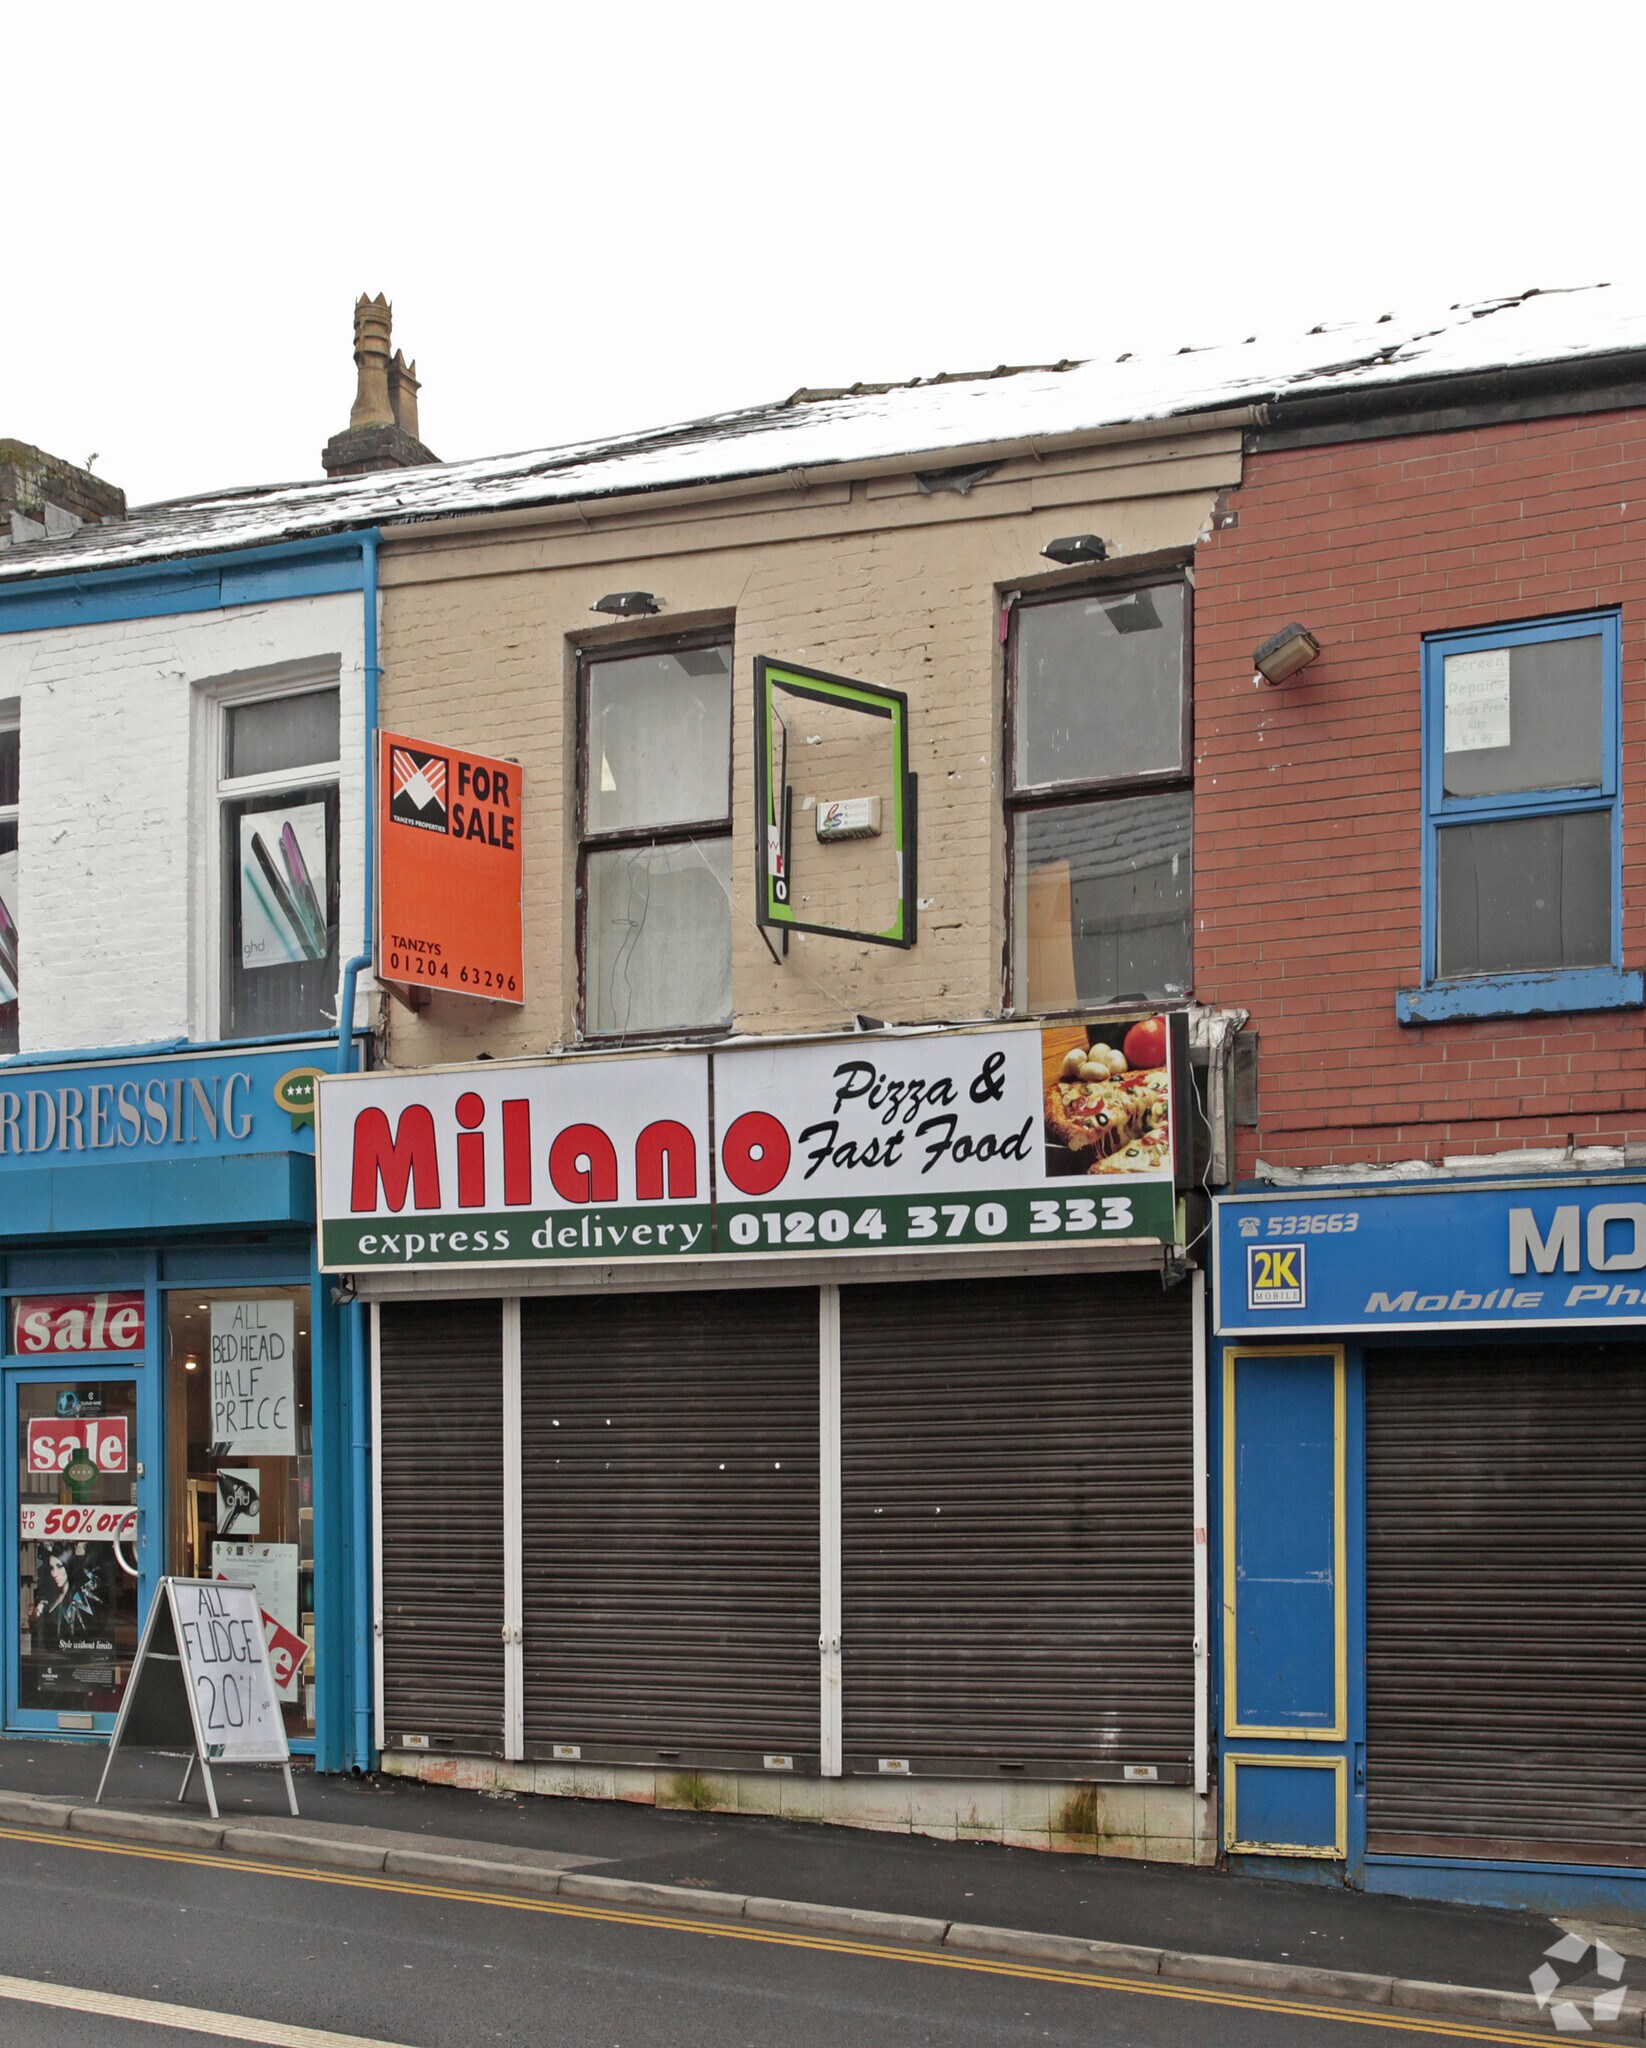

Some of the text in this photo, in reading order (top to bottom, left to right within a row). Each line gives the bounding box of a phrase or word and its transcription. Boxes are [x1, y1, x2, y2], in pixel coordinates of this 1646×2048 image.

[1451, 656, 1504, 673] Screen
[1448, 679, 1505, 698] Repairs
[458, 761, 509, 809] FOR
[393, 815, 446, 833] TANZYS PROPERTIES
[452, 803, 514, 850] SALE
[244, 938, 265, 958] ghd
[391, 935, 441, 956] TANZYS
[391, 953, 516, 991] 01204 63296
[832, 1051, 1005, 1124] Pizza &
[0, 1072, 253, 1154] RDRESSING
[350, 1092, 791, 1213] Milano
[798, 1113, 1034, 1181] Fast Food
[358, 1215, 703, 1261] express delivery
[729, 1197, 1134, 1246] 01204 370 333
[1266, 1212, 1359, 1236] 533663
[1508, 1202, 1646, 1275] MO
[1254, 1251, 1300, 1288] 2K
[1255, 1290, 1298, 1301] MOBILE
[1364, 1288, 1544, 1314] Mobile
[24, 1294, 139, 1351] sale
[232, 1304, 267, 1330] ALL
[214, 1366, 263, 1399] HALF
[215, 1396, 287, 1433] PRICE
[22, 1511, 35, 1520] UP
[22, 1521, 35, 1530] TO
[44, 1508, 137, 1534] 50% OFF
[199, 1588, 230, 1618] ALL
[59, 1639, 112, 1651] Style without limits
[182, 1620, 262, 1663] FUDGE
